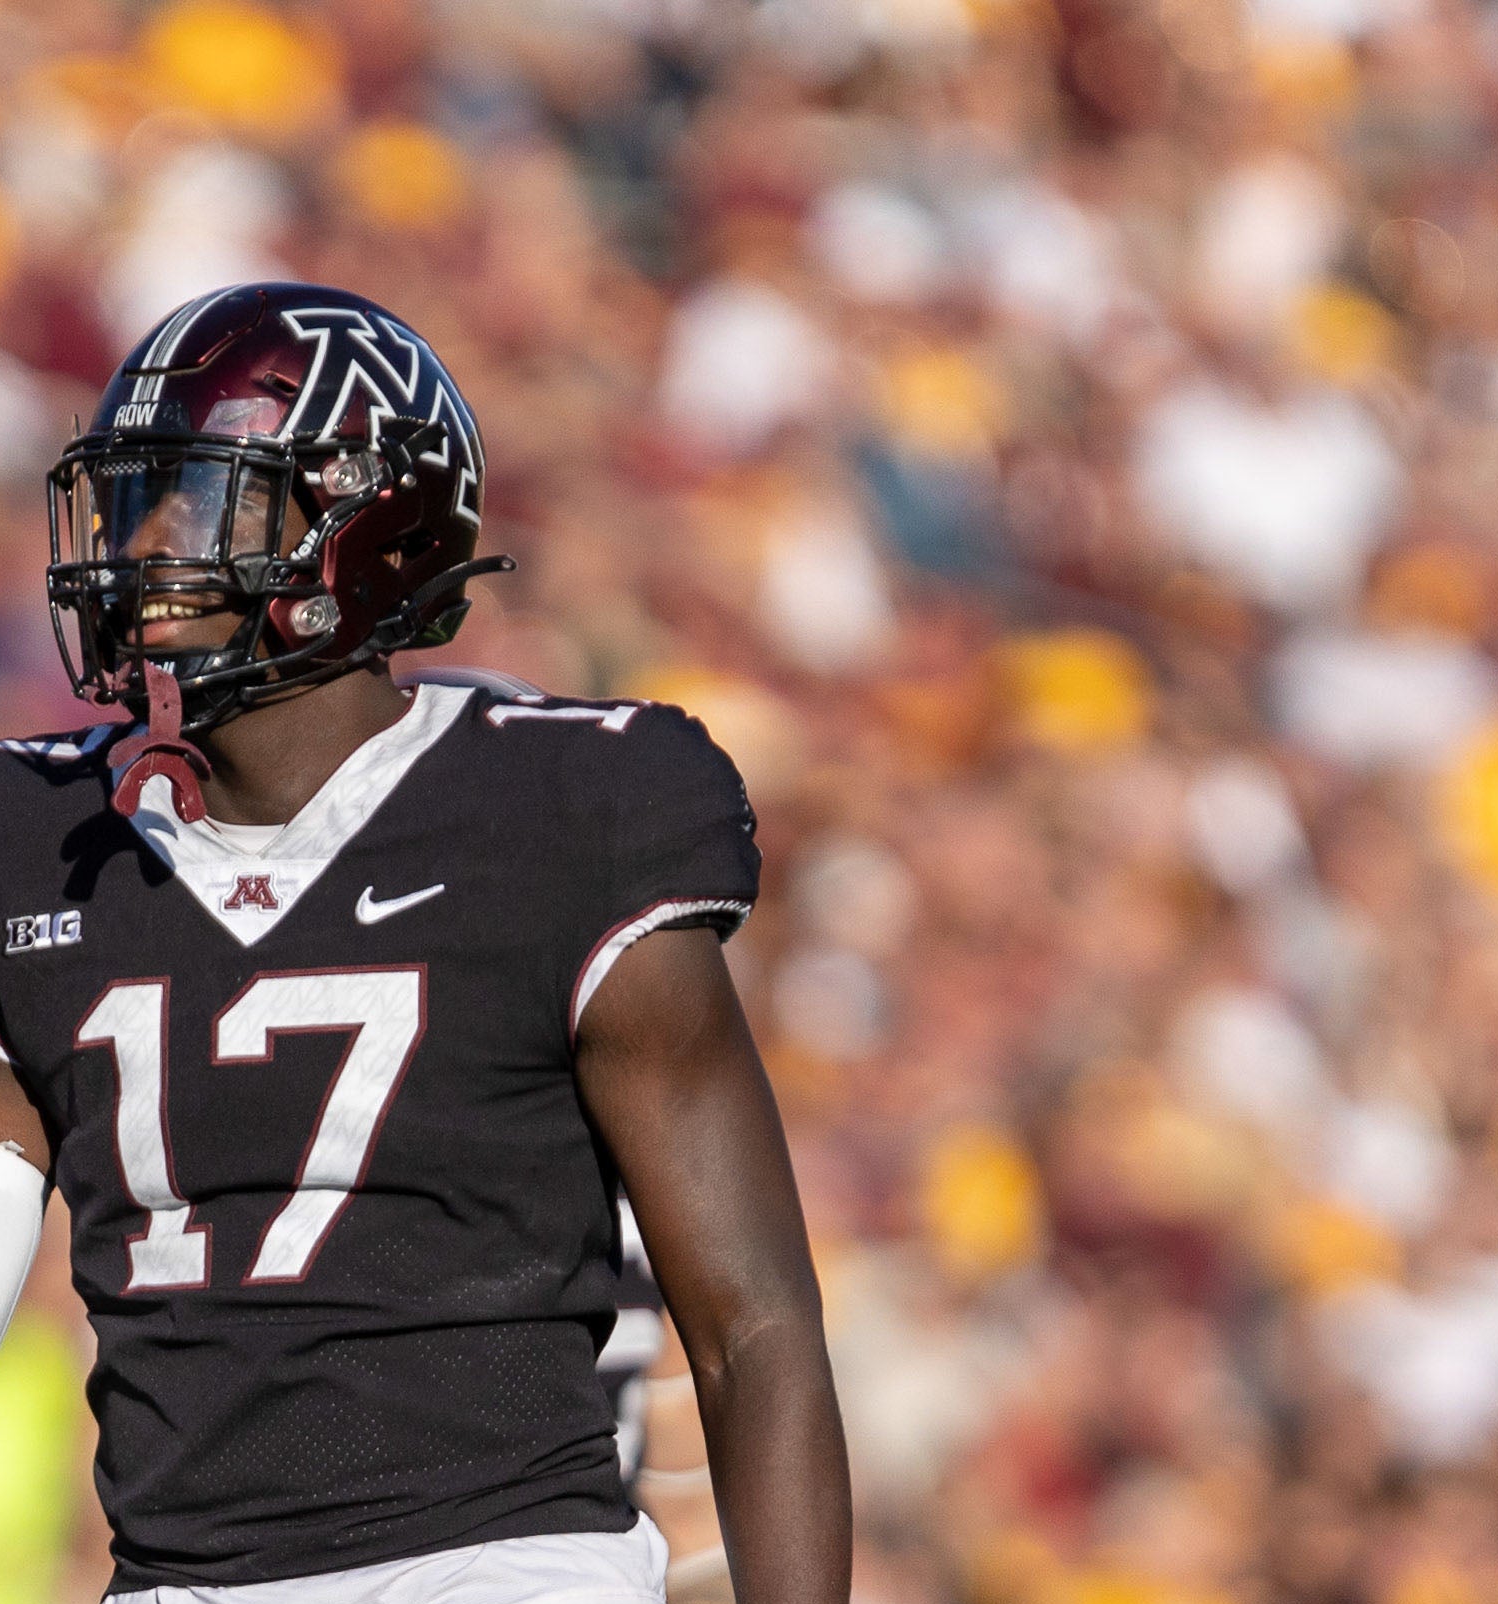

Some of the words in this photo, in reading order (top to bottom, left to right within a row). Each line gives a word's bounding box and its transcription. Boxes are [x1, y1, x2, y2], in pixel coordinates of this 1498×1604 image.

[113, 402, 159, 428] ROW
[222, 872, 280, 911] M
[73, 963, 428, 1296] 17
